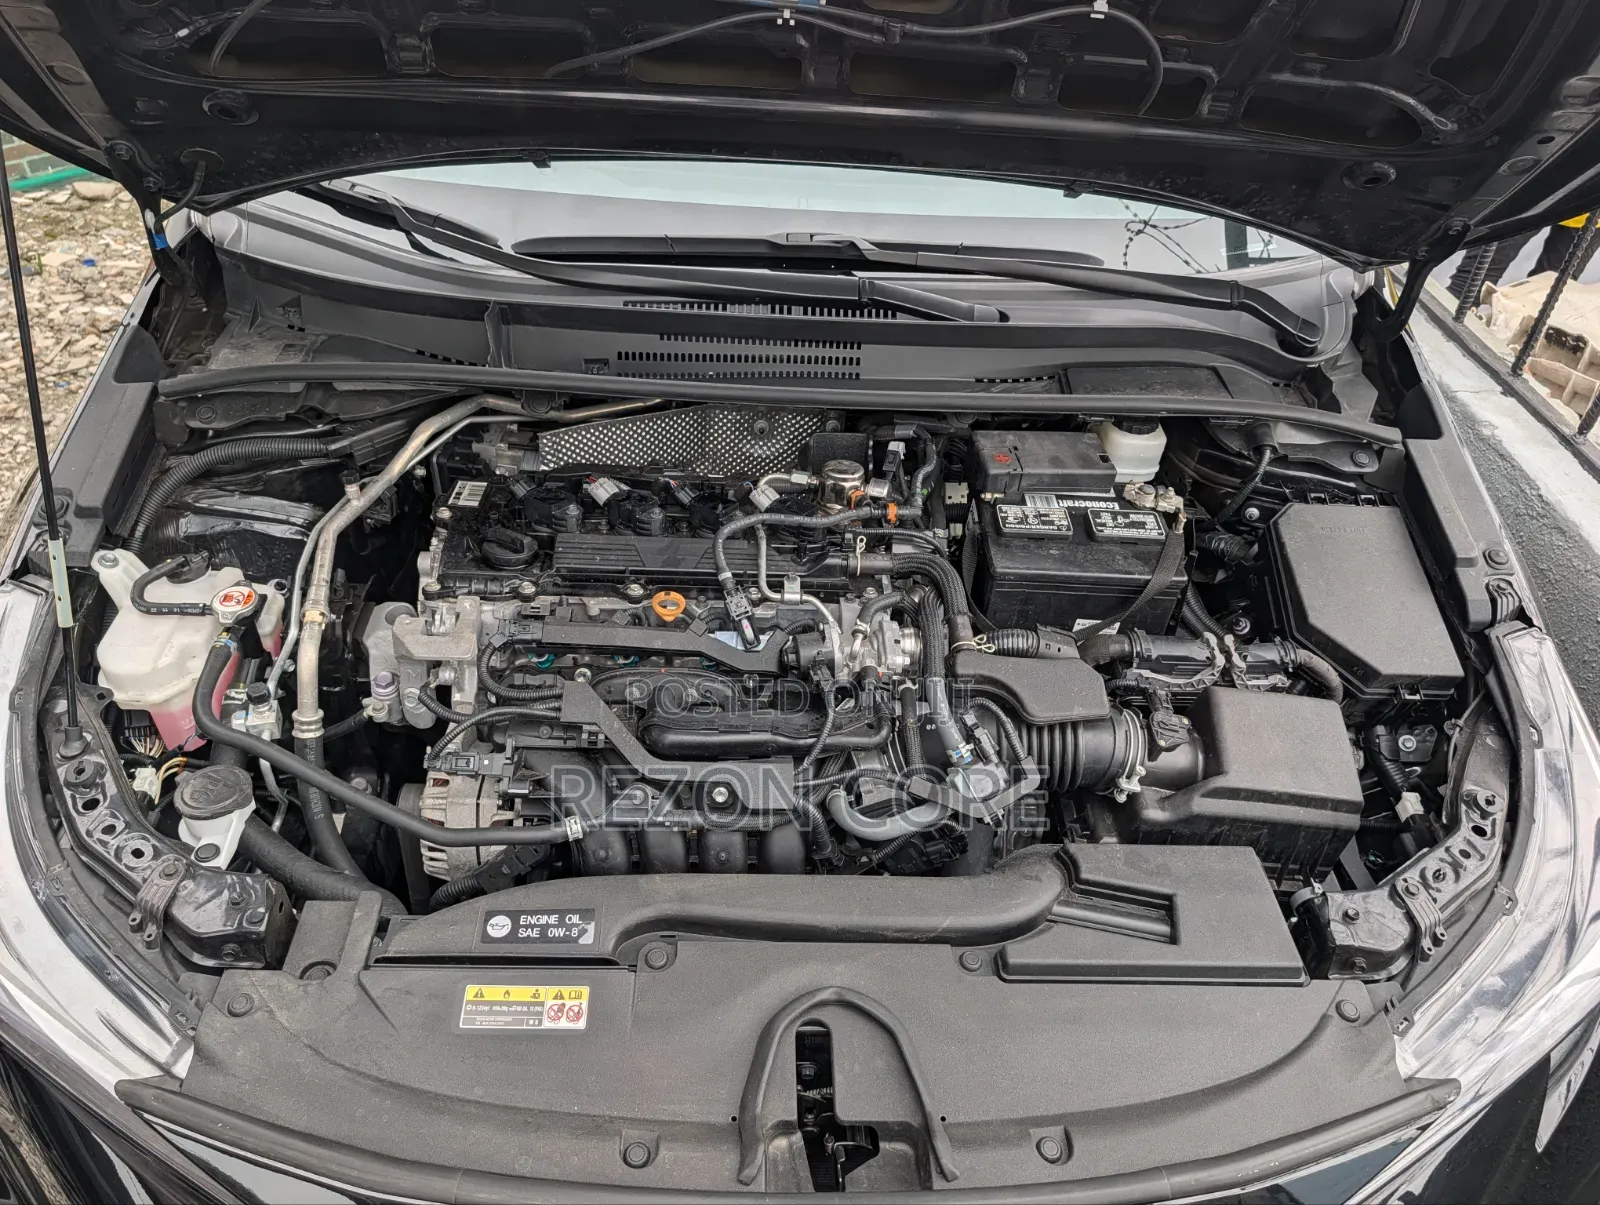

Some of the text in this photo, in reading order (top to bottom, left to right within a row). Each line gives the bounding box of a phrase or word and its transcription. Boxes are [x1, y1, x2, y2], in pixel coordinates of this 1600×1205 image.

[1058, 499, 1119, 510] Econocraft
[519, 914, 583, 925] ENGINE OIL
[518, 927, 579, 938] SAE 0W-8
